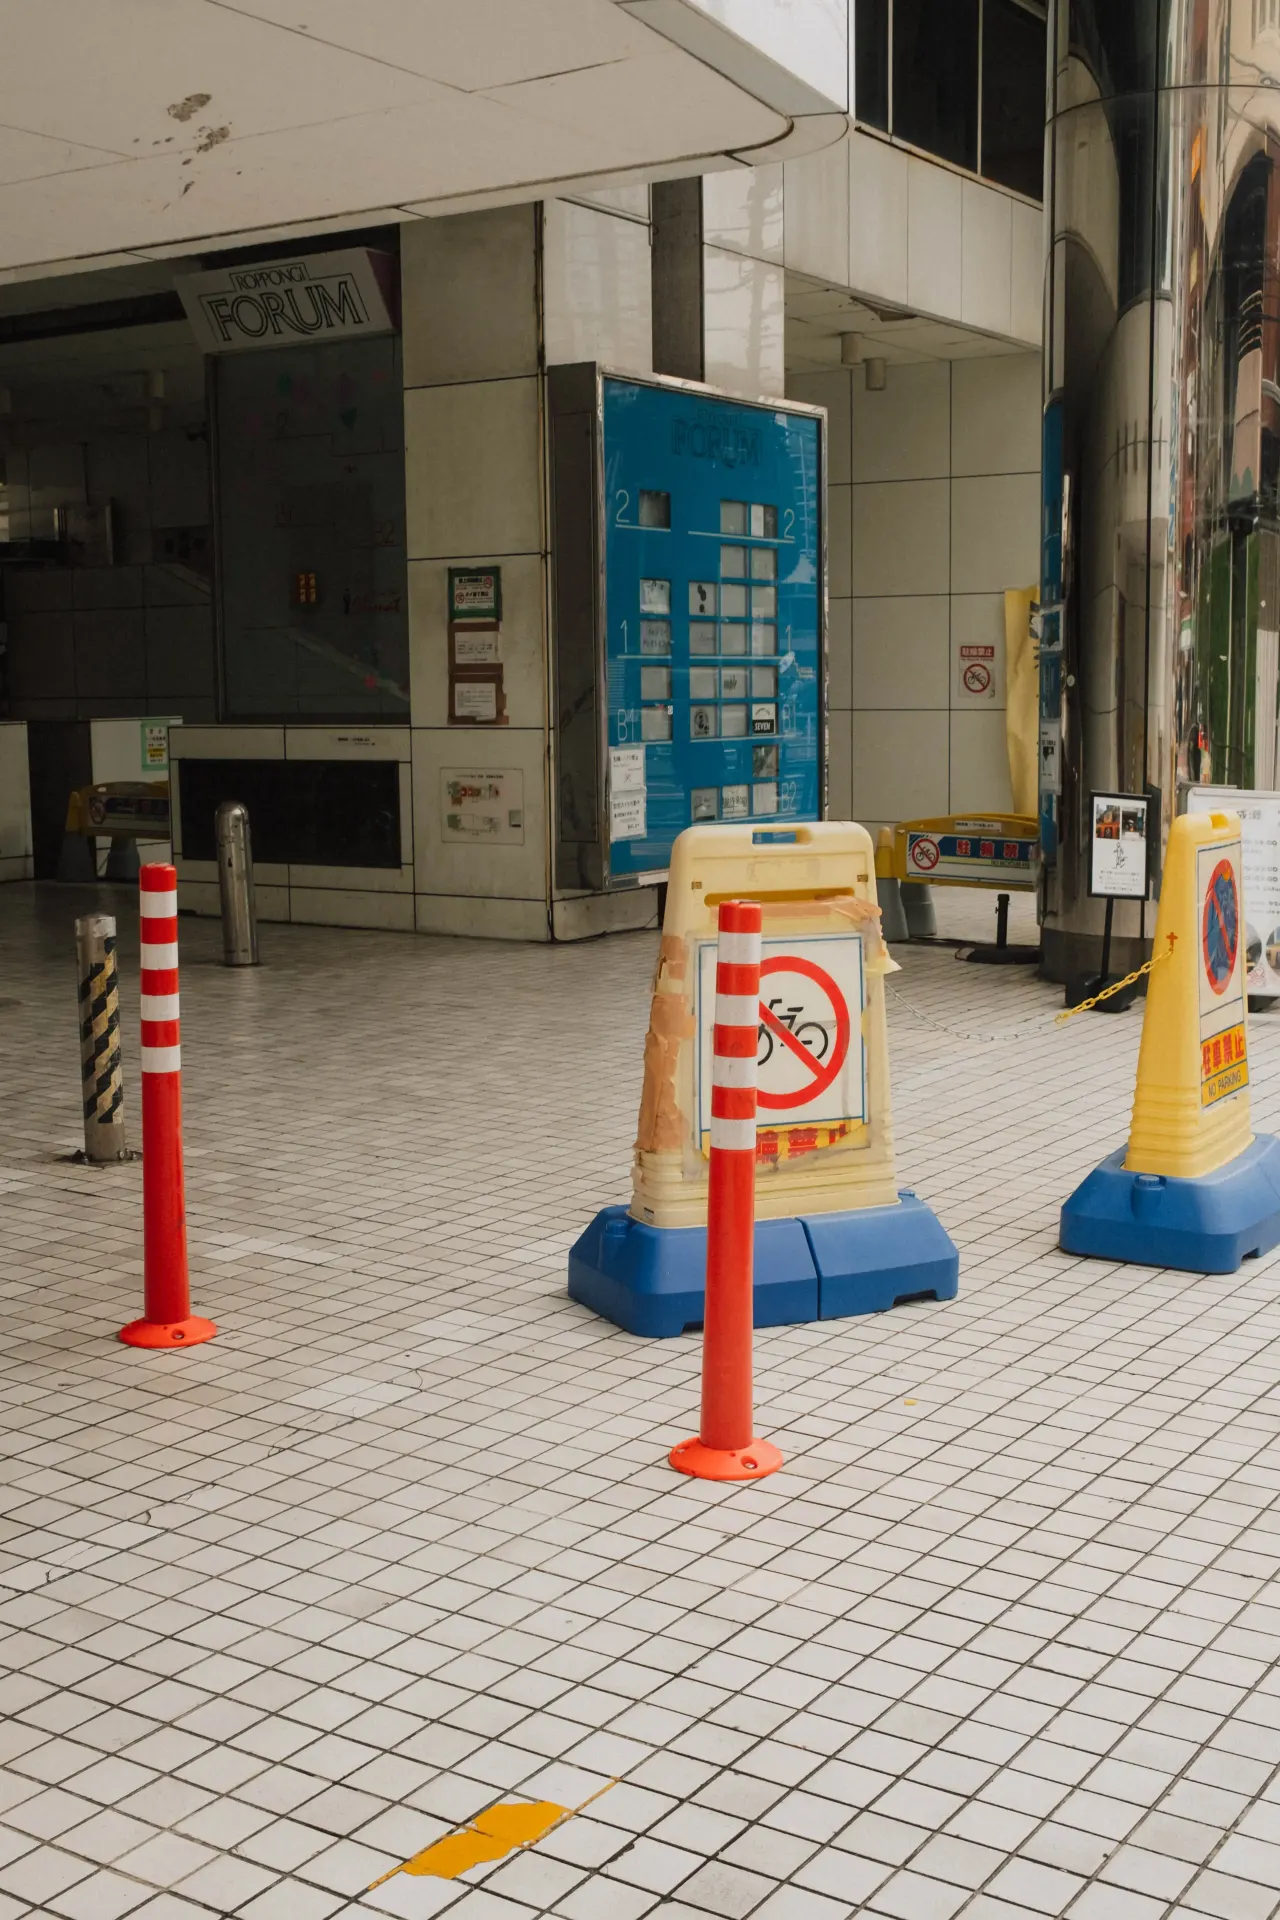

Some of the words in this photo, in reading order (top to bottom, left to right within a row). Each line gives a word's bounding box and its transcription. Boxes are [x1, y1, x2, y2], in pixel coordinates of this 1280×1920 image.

[235, 266, 305, 290] ROPPONGI
[207, 281, 364, 342] FORUM
[671, 419, 763, 469] FORUM
[615, 489, 630, 523] 2
[783, 508, 796, 540] 2
[619, 619, 629, 654] 1
[754, 722, 771, 732] SEVEN
[1202, 1029, 1245, 1076] 駐車禁止
[1208, 1082, 1217, 1097] NO
[1217, 1069, 1242, 1092] PARKING
